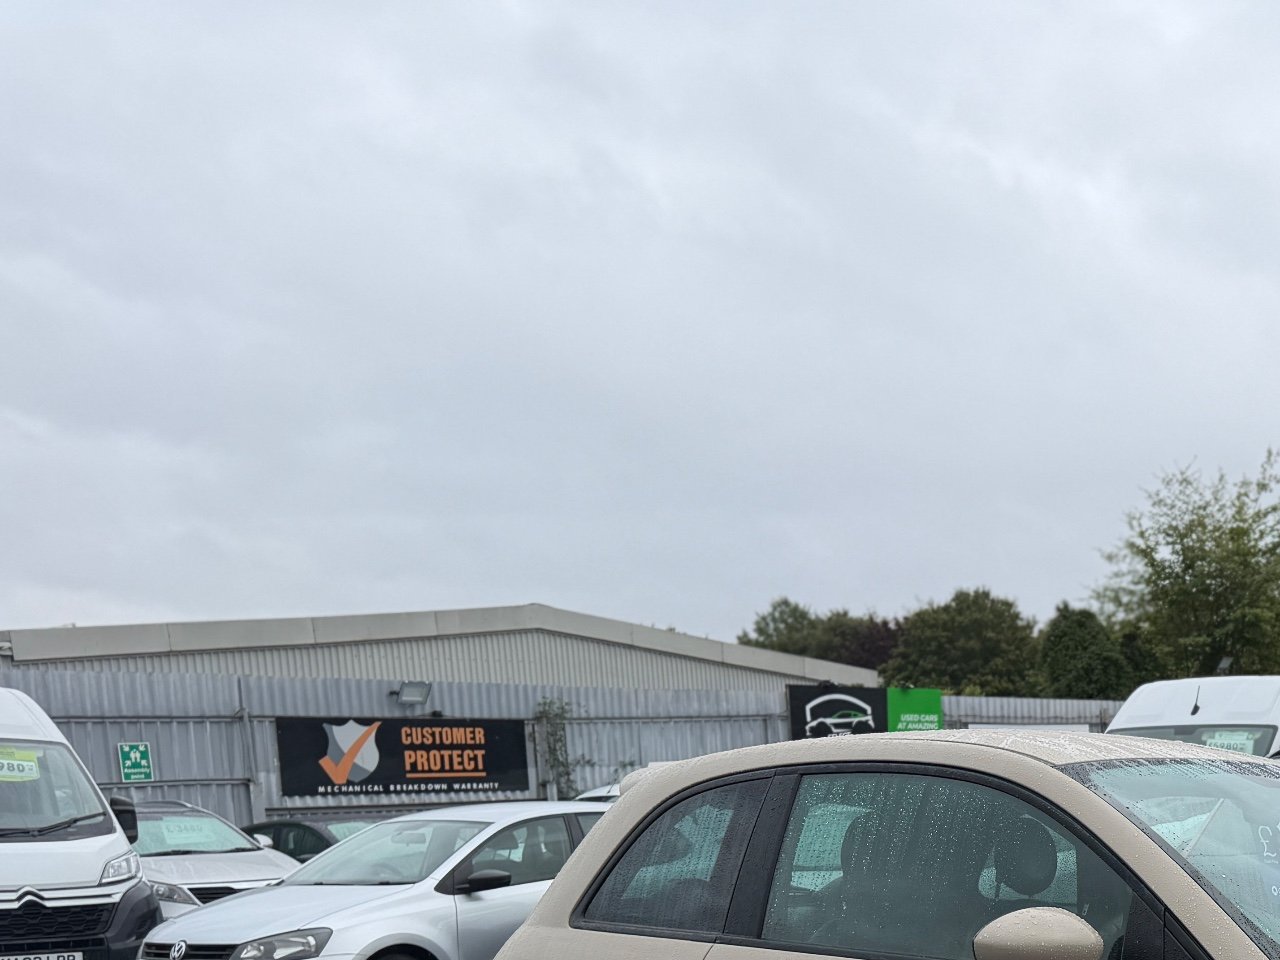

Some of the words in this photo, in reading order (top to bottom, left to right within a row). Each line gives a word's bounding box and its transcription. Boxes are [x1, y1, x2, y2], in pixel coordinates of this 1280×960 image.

[900, 714, 919, 722] USED
[920, 714, 938, 722] CARS
[897, 722, 906, 730] AT
[907, 721, 939, 730] AMAZING
[401, 726, 485, 745] CUSTOMER
[403, 749, 486, 772] PROTECT
[318, 784, 384, 793] MECHANICAL
[389, 783, 448, 792] BREAKDOWN
[453, 782, 500, 791] WARRANTY
